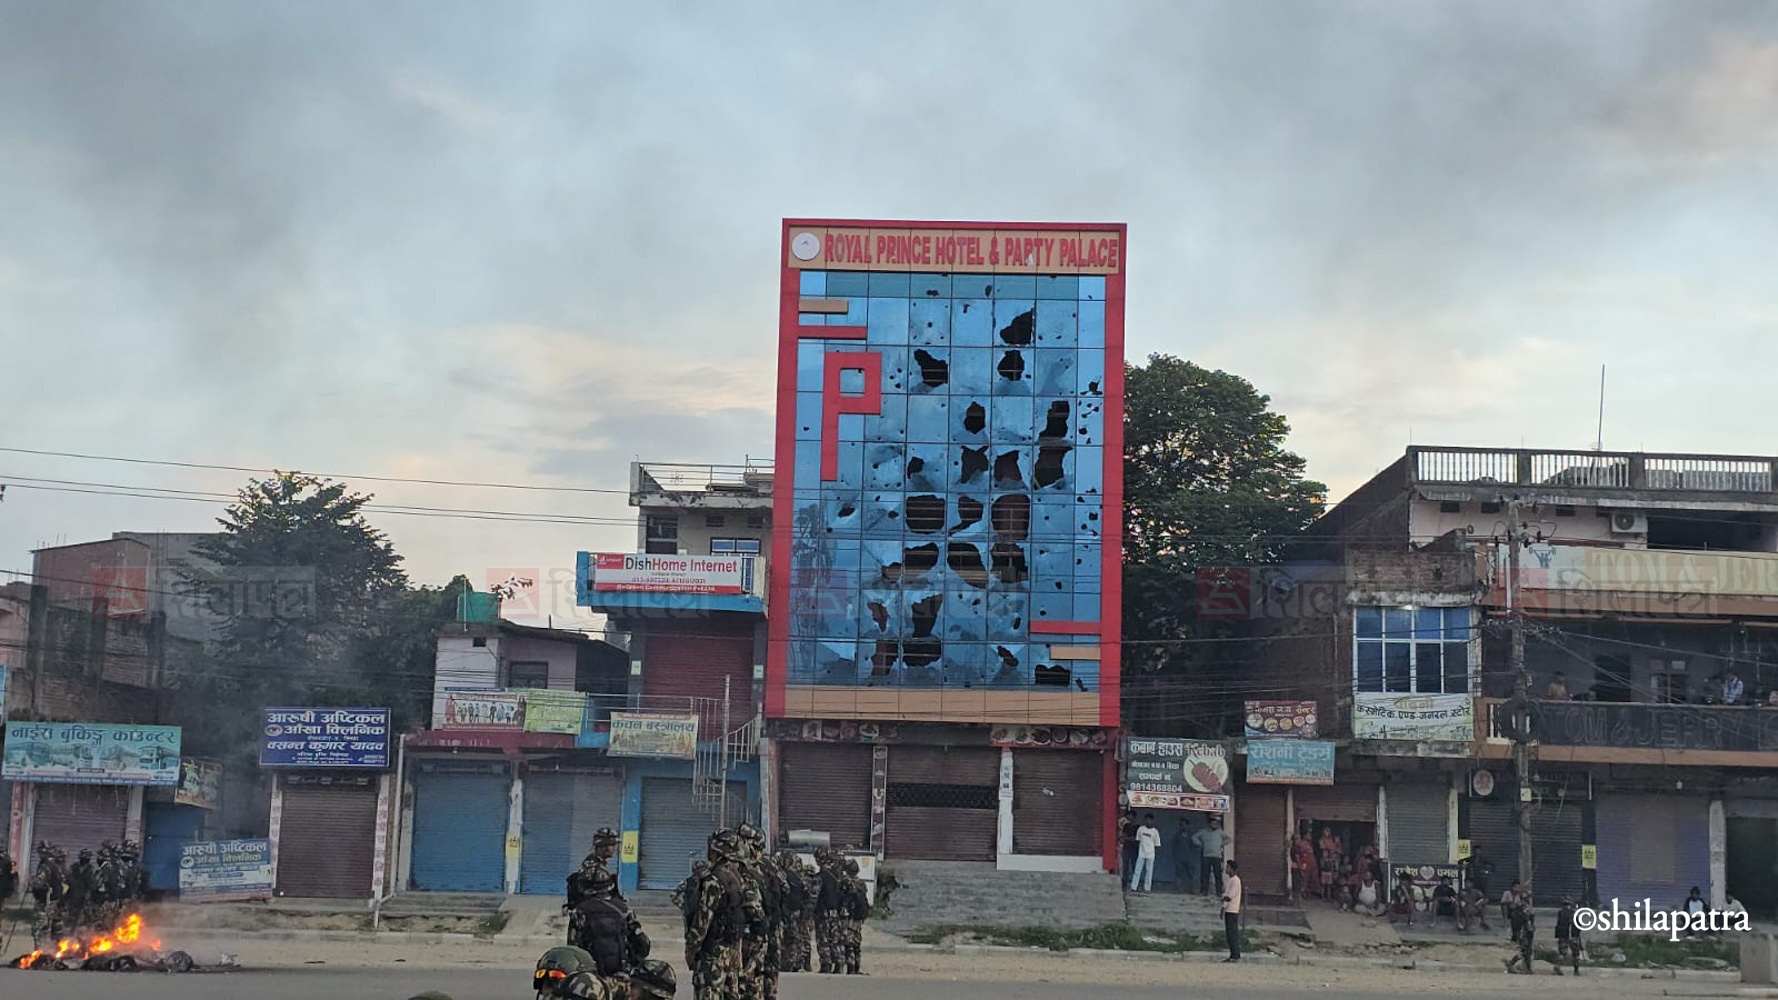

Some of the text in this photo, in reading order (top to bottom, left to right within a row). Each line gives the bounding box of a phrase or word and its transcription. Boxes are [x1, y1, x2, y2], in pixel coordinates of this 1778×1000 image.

[824, 233, 1118, 267] ROYAL PRINCE HOTEL & PARTY PALACE
[625, 557, 738, 573] DishHome Internet
[1592, 551, 1670, 587] TOM
[113, 729, 175, 744] काउन्टर
[326, 723, 386, 735] क्लिनिक
[309, 741, 346, 751] कुमार
[350, 741, 384, 750] यादव
[1250, 743, 1294, 760] रोशनी
